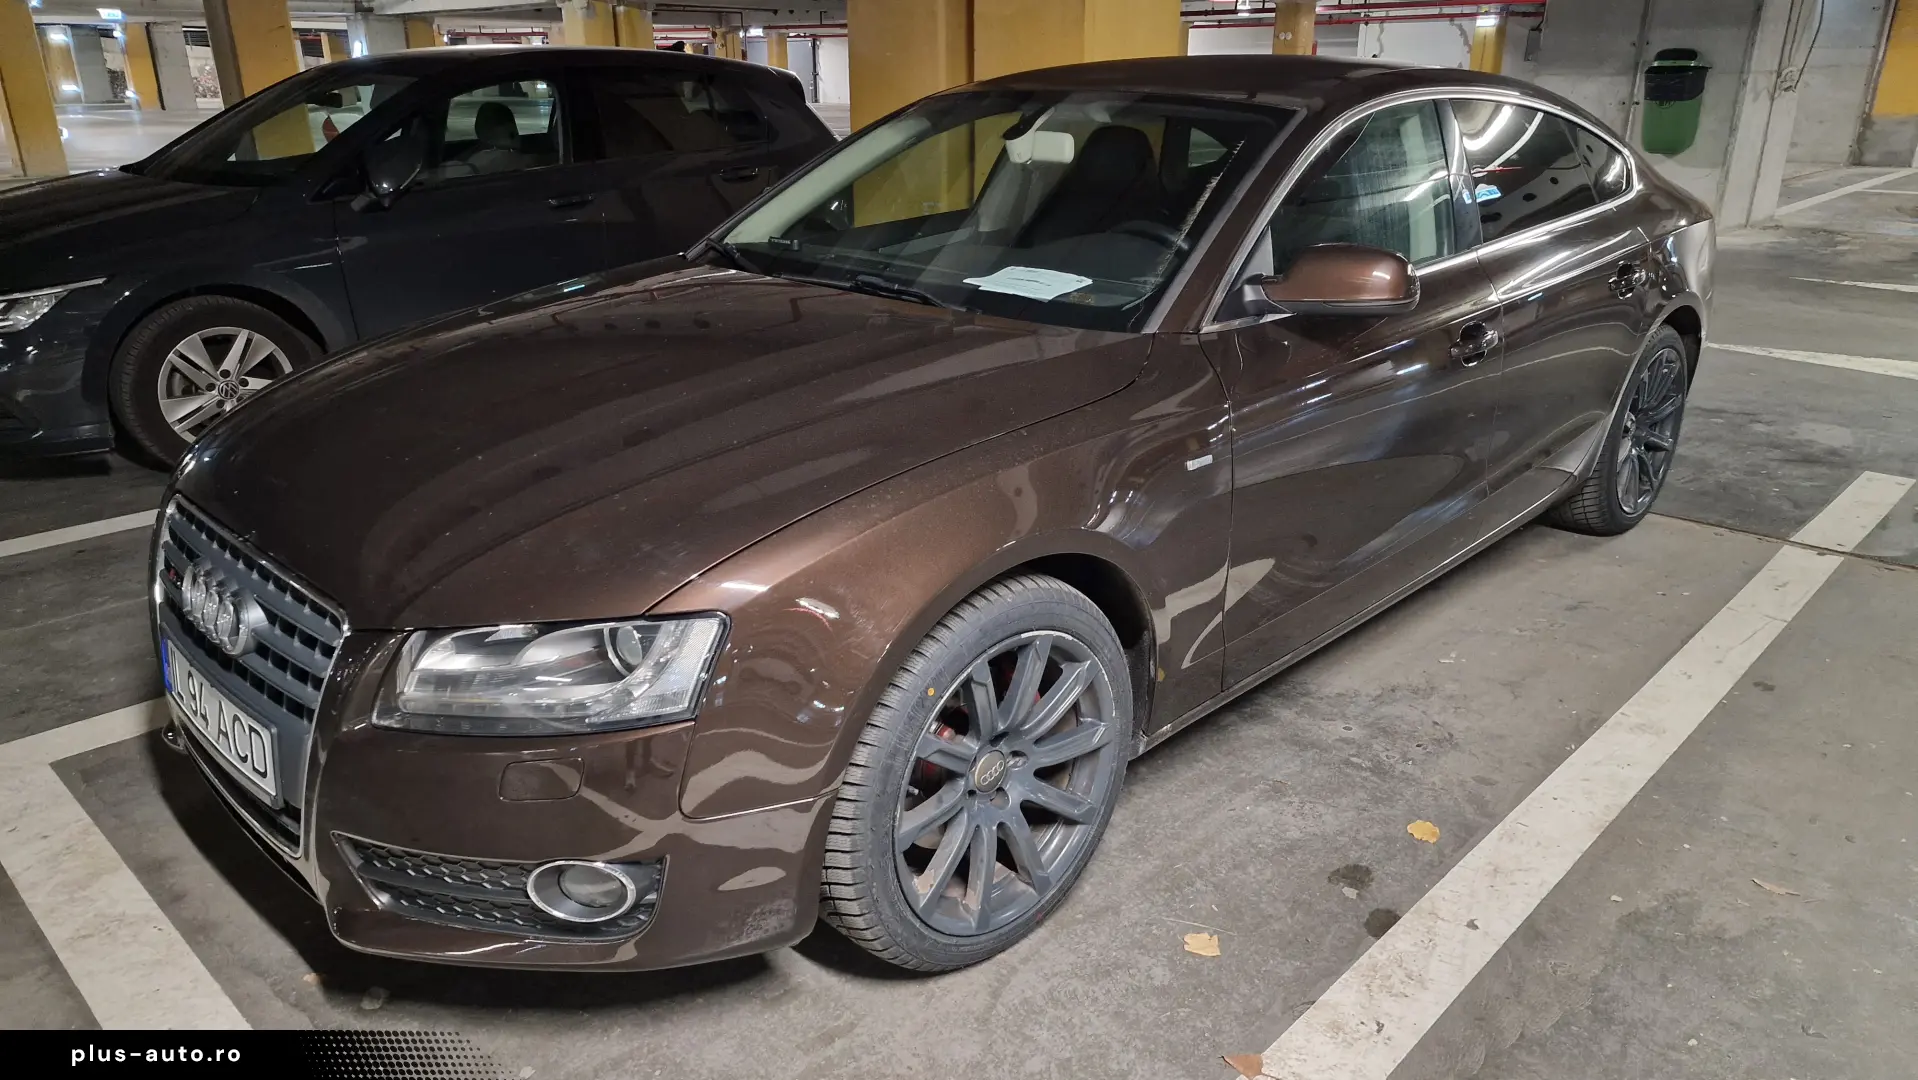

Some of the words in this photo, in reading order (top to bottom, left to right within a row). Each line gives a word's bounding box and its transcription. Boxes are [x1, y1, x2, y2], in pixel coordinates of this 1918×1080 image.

[170, 647, 186, 704] IL
[187, 670, 210, 730] 94
[217, 700, 268, 779] ACD
